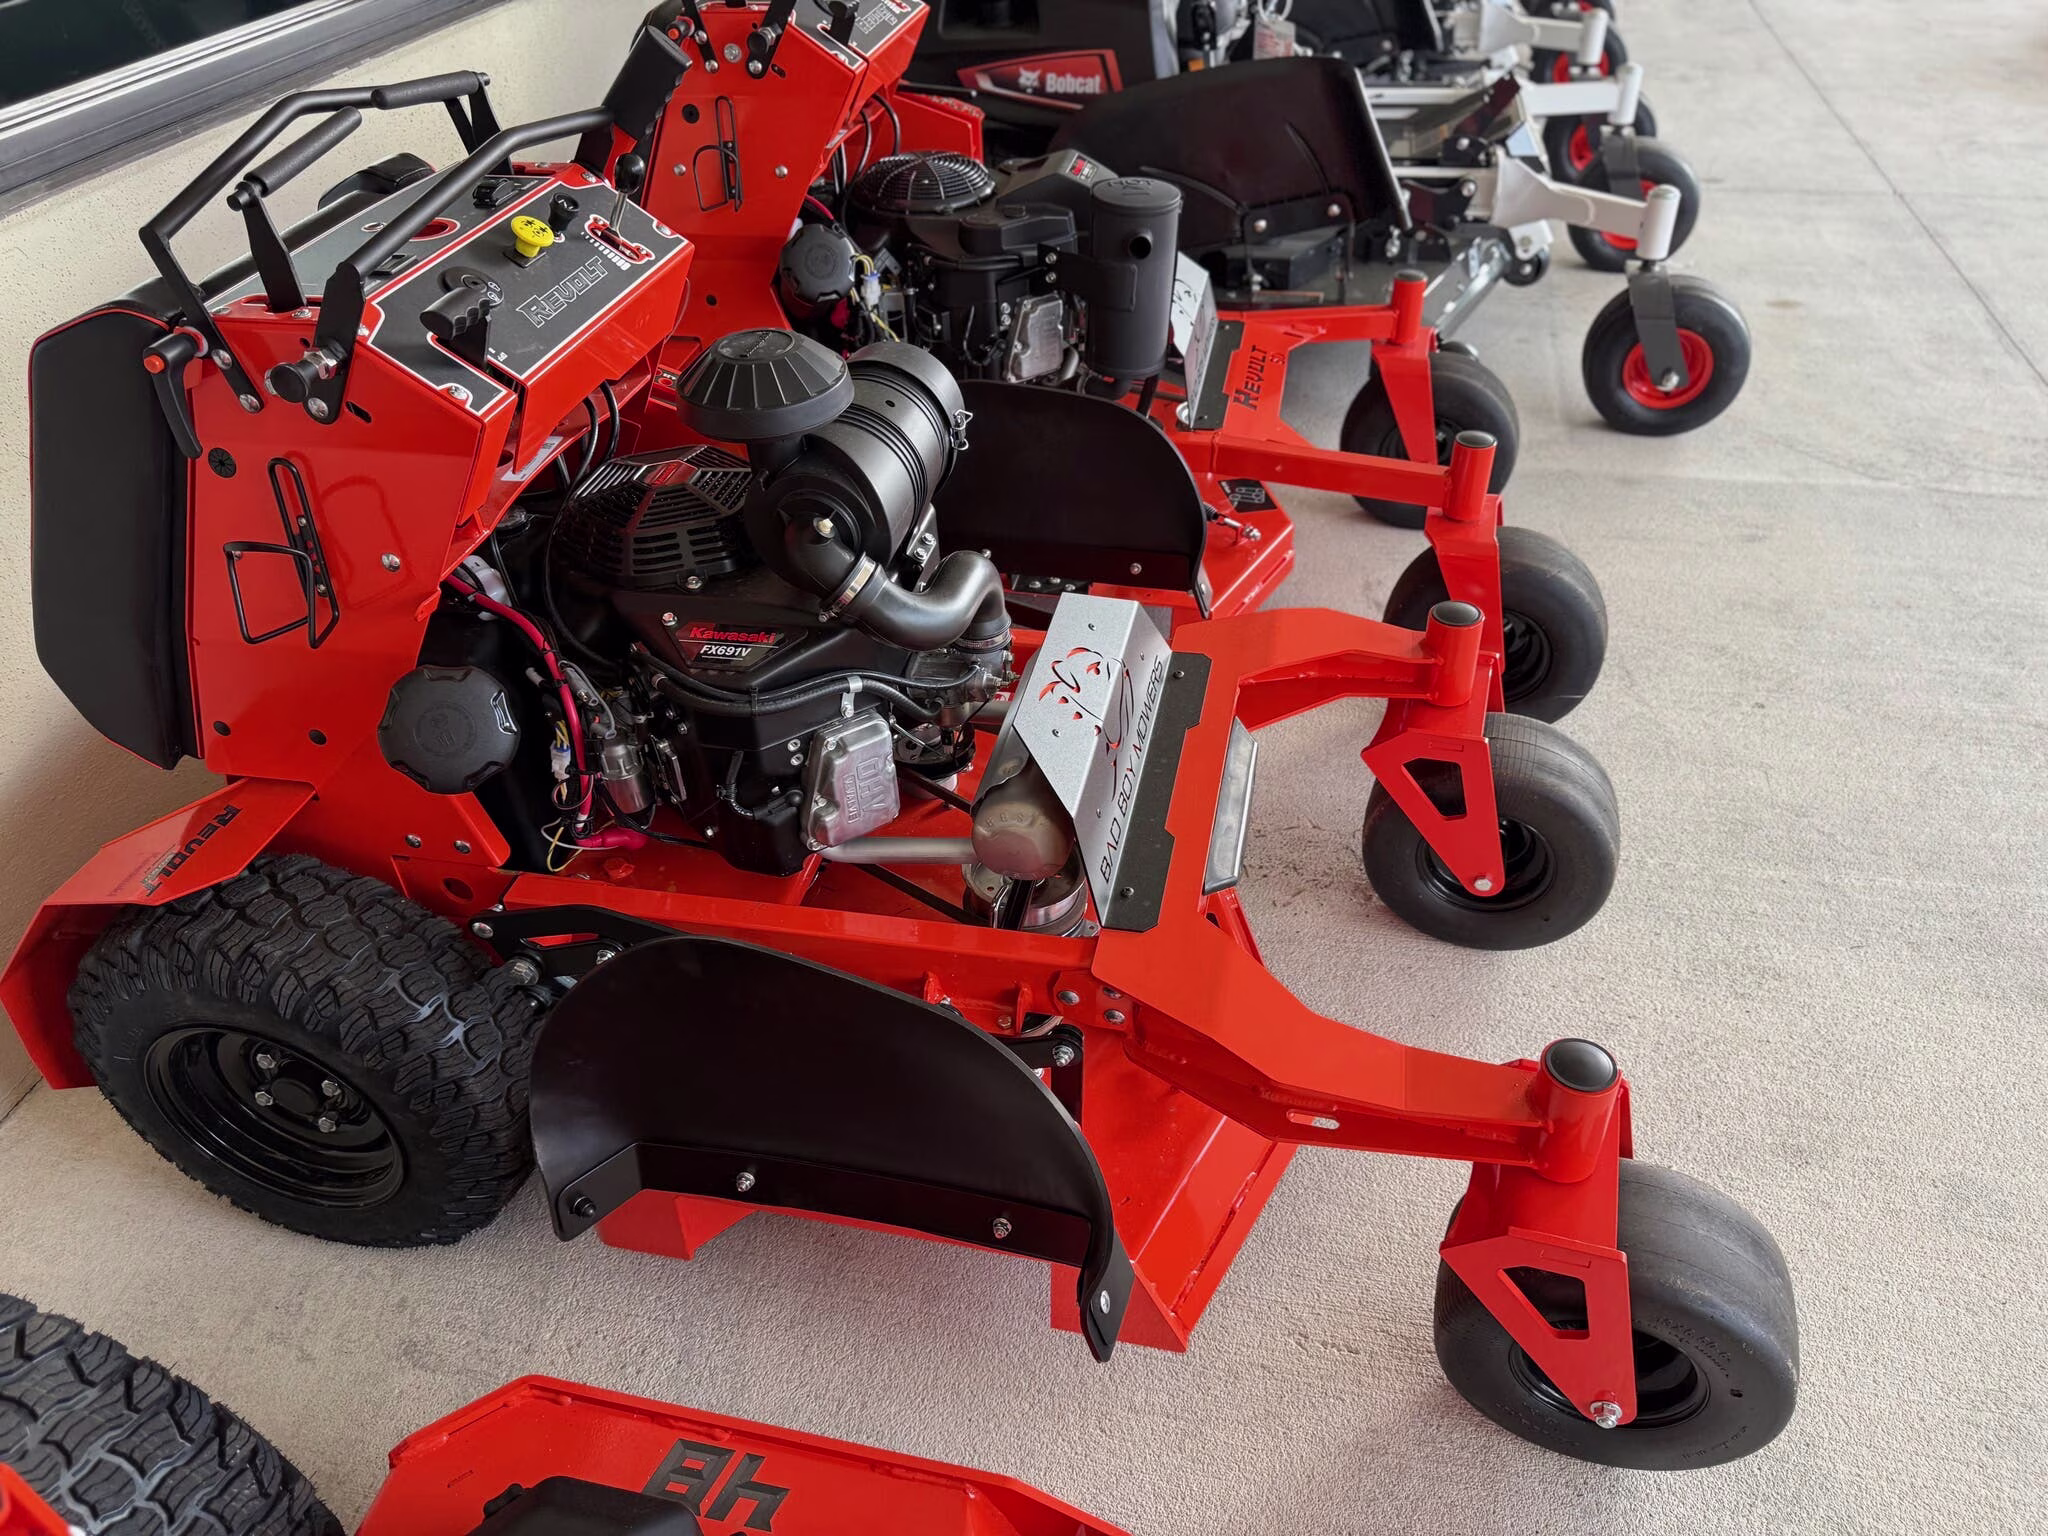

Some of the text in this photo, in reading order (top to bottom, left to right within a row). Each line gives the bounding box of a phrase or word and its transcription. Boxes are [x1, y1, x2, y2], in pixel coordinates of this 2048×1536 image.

[1045, 72, 1102, 94] Bobcat
[515, 255, 608, 328] REVOLT
[689, 626, 778, 644] Kawasaki
[700, 644, 752, 657] FX691V
[1100, 654, 1164, 884] BAD BOY MOWERS
